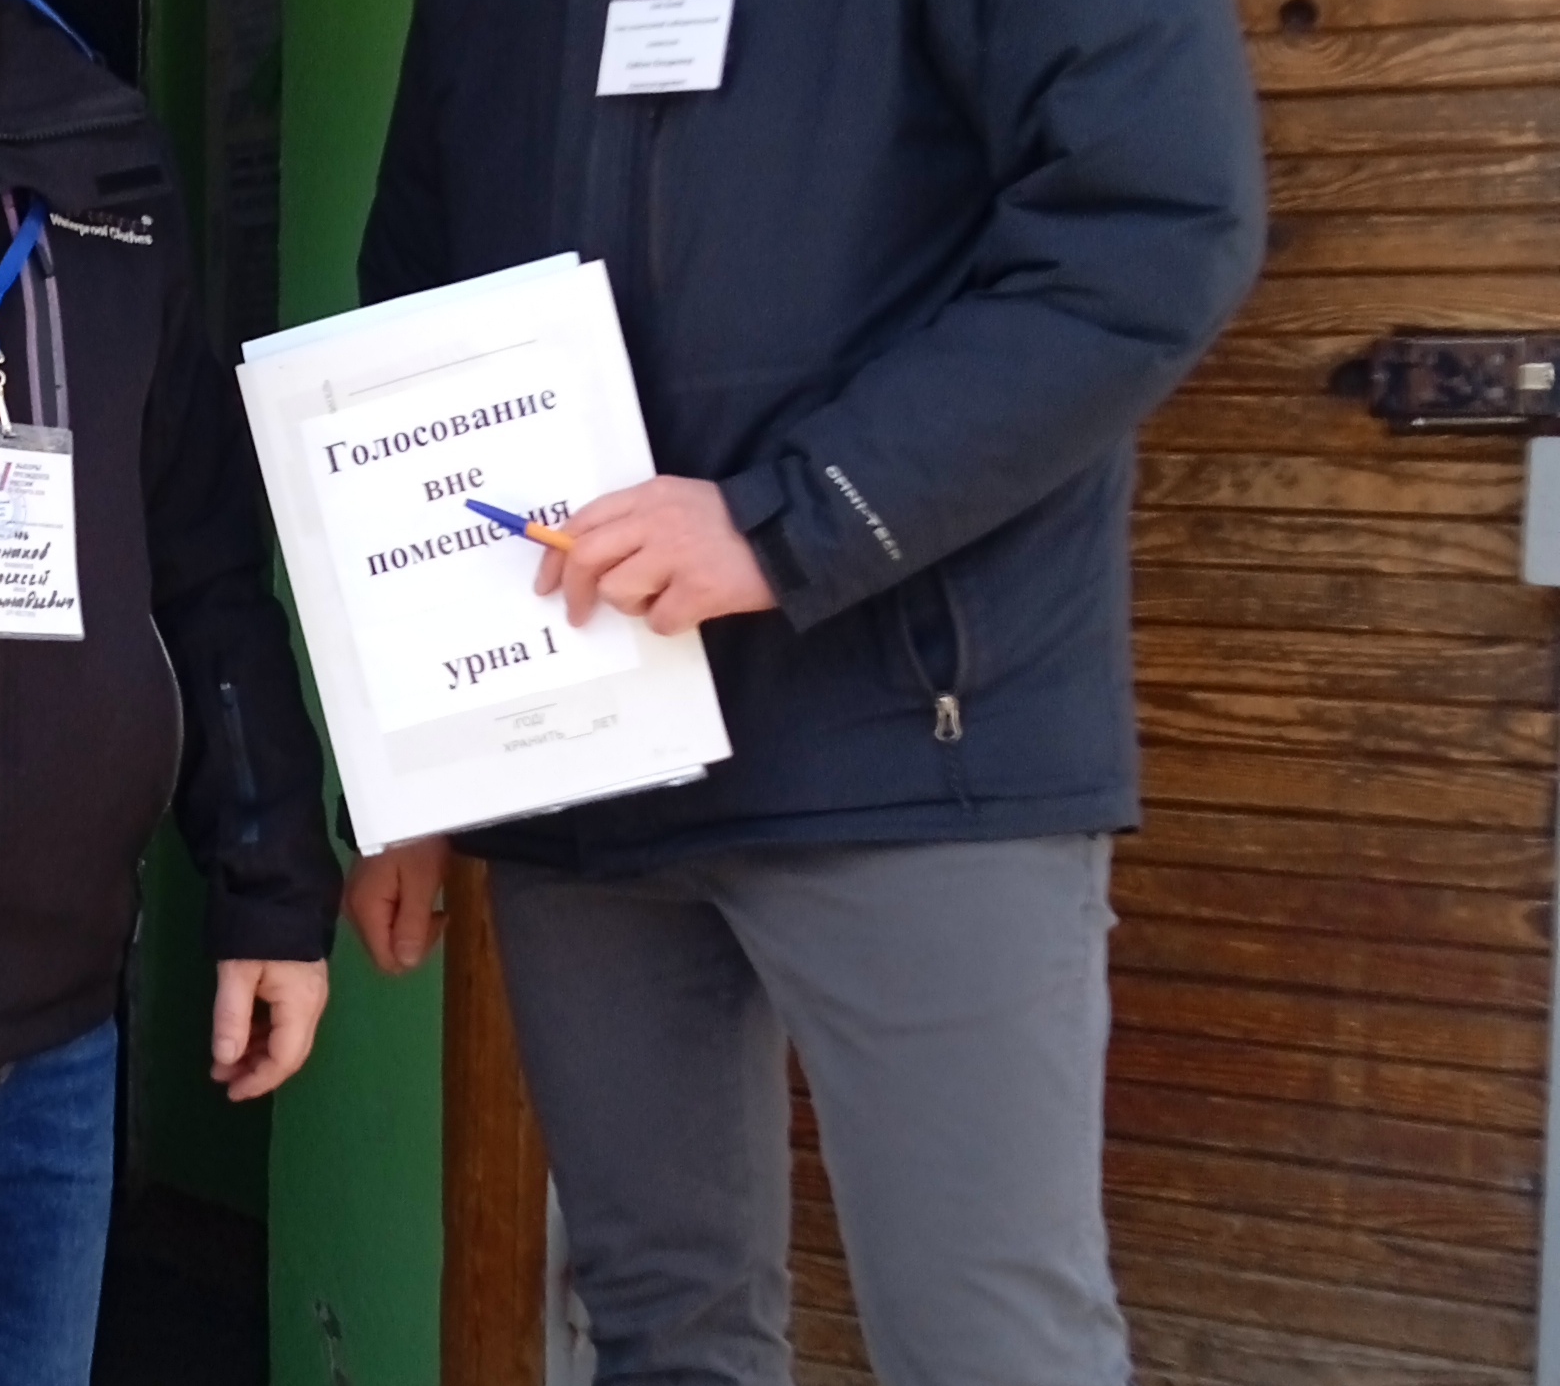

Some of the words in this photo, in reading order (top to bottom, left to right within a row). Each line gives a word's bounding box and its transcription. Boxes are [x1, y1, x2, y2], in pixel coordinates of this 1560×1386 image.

[323, 387, 559, 475] Голосование
[422, 465, 486, 503] вне
[366, 498, 572, 578] помещеия
[442, 639, 531, 691] урна
[541, 625, 559, 656] 1
